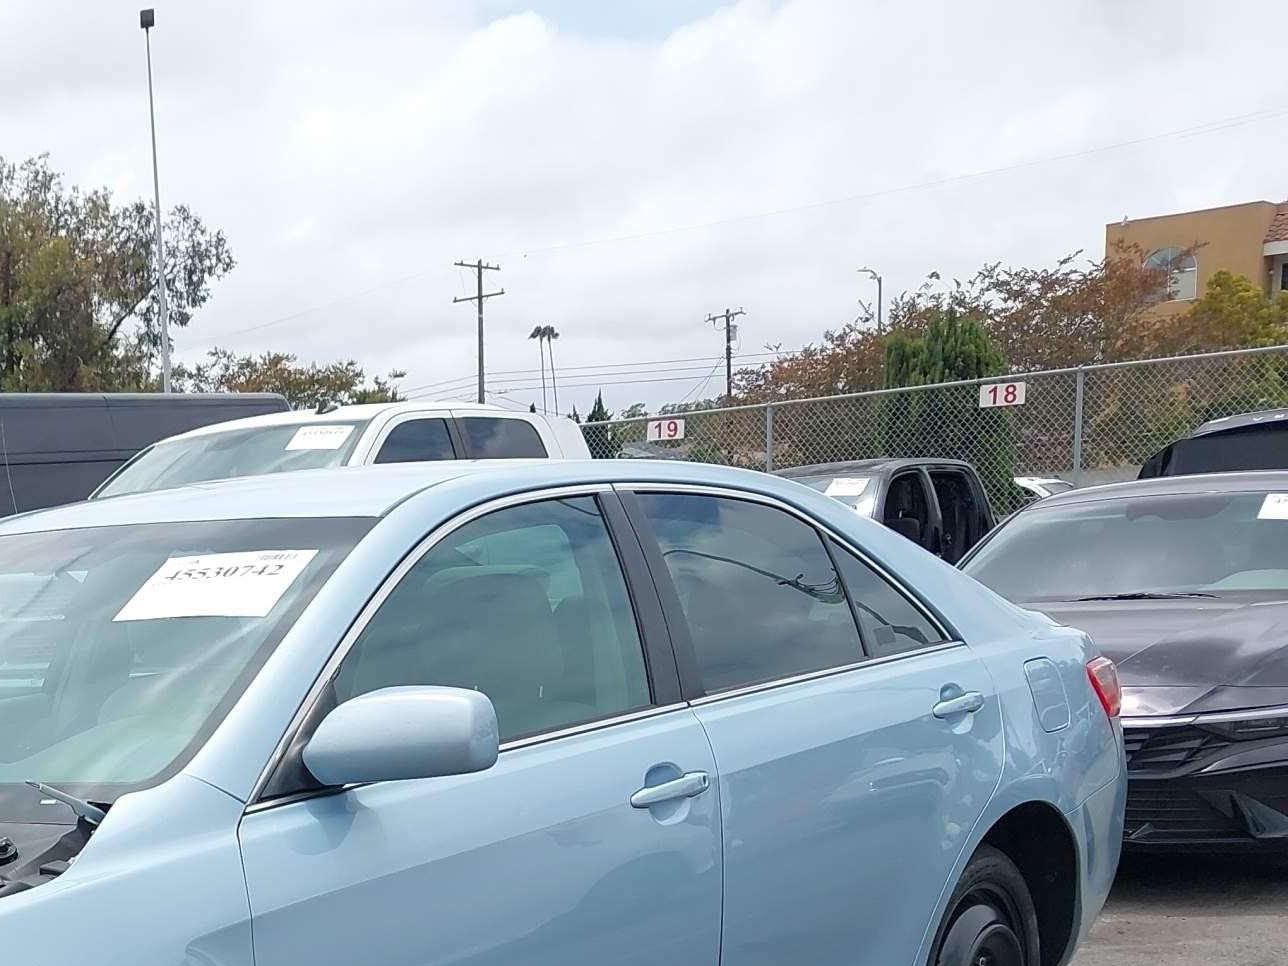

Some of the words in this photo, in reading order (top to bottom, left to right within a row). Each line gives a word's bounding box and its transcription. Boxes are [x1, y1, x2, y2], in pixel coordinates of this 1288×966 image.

[988, 384, 1017, 405] 18
[654, 421, 679, 439] 19
[165, 564, 286, 581] 45530742
